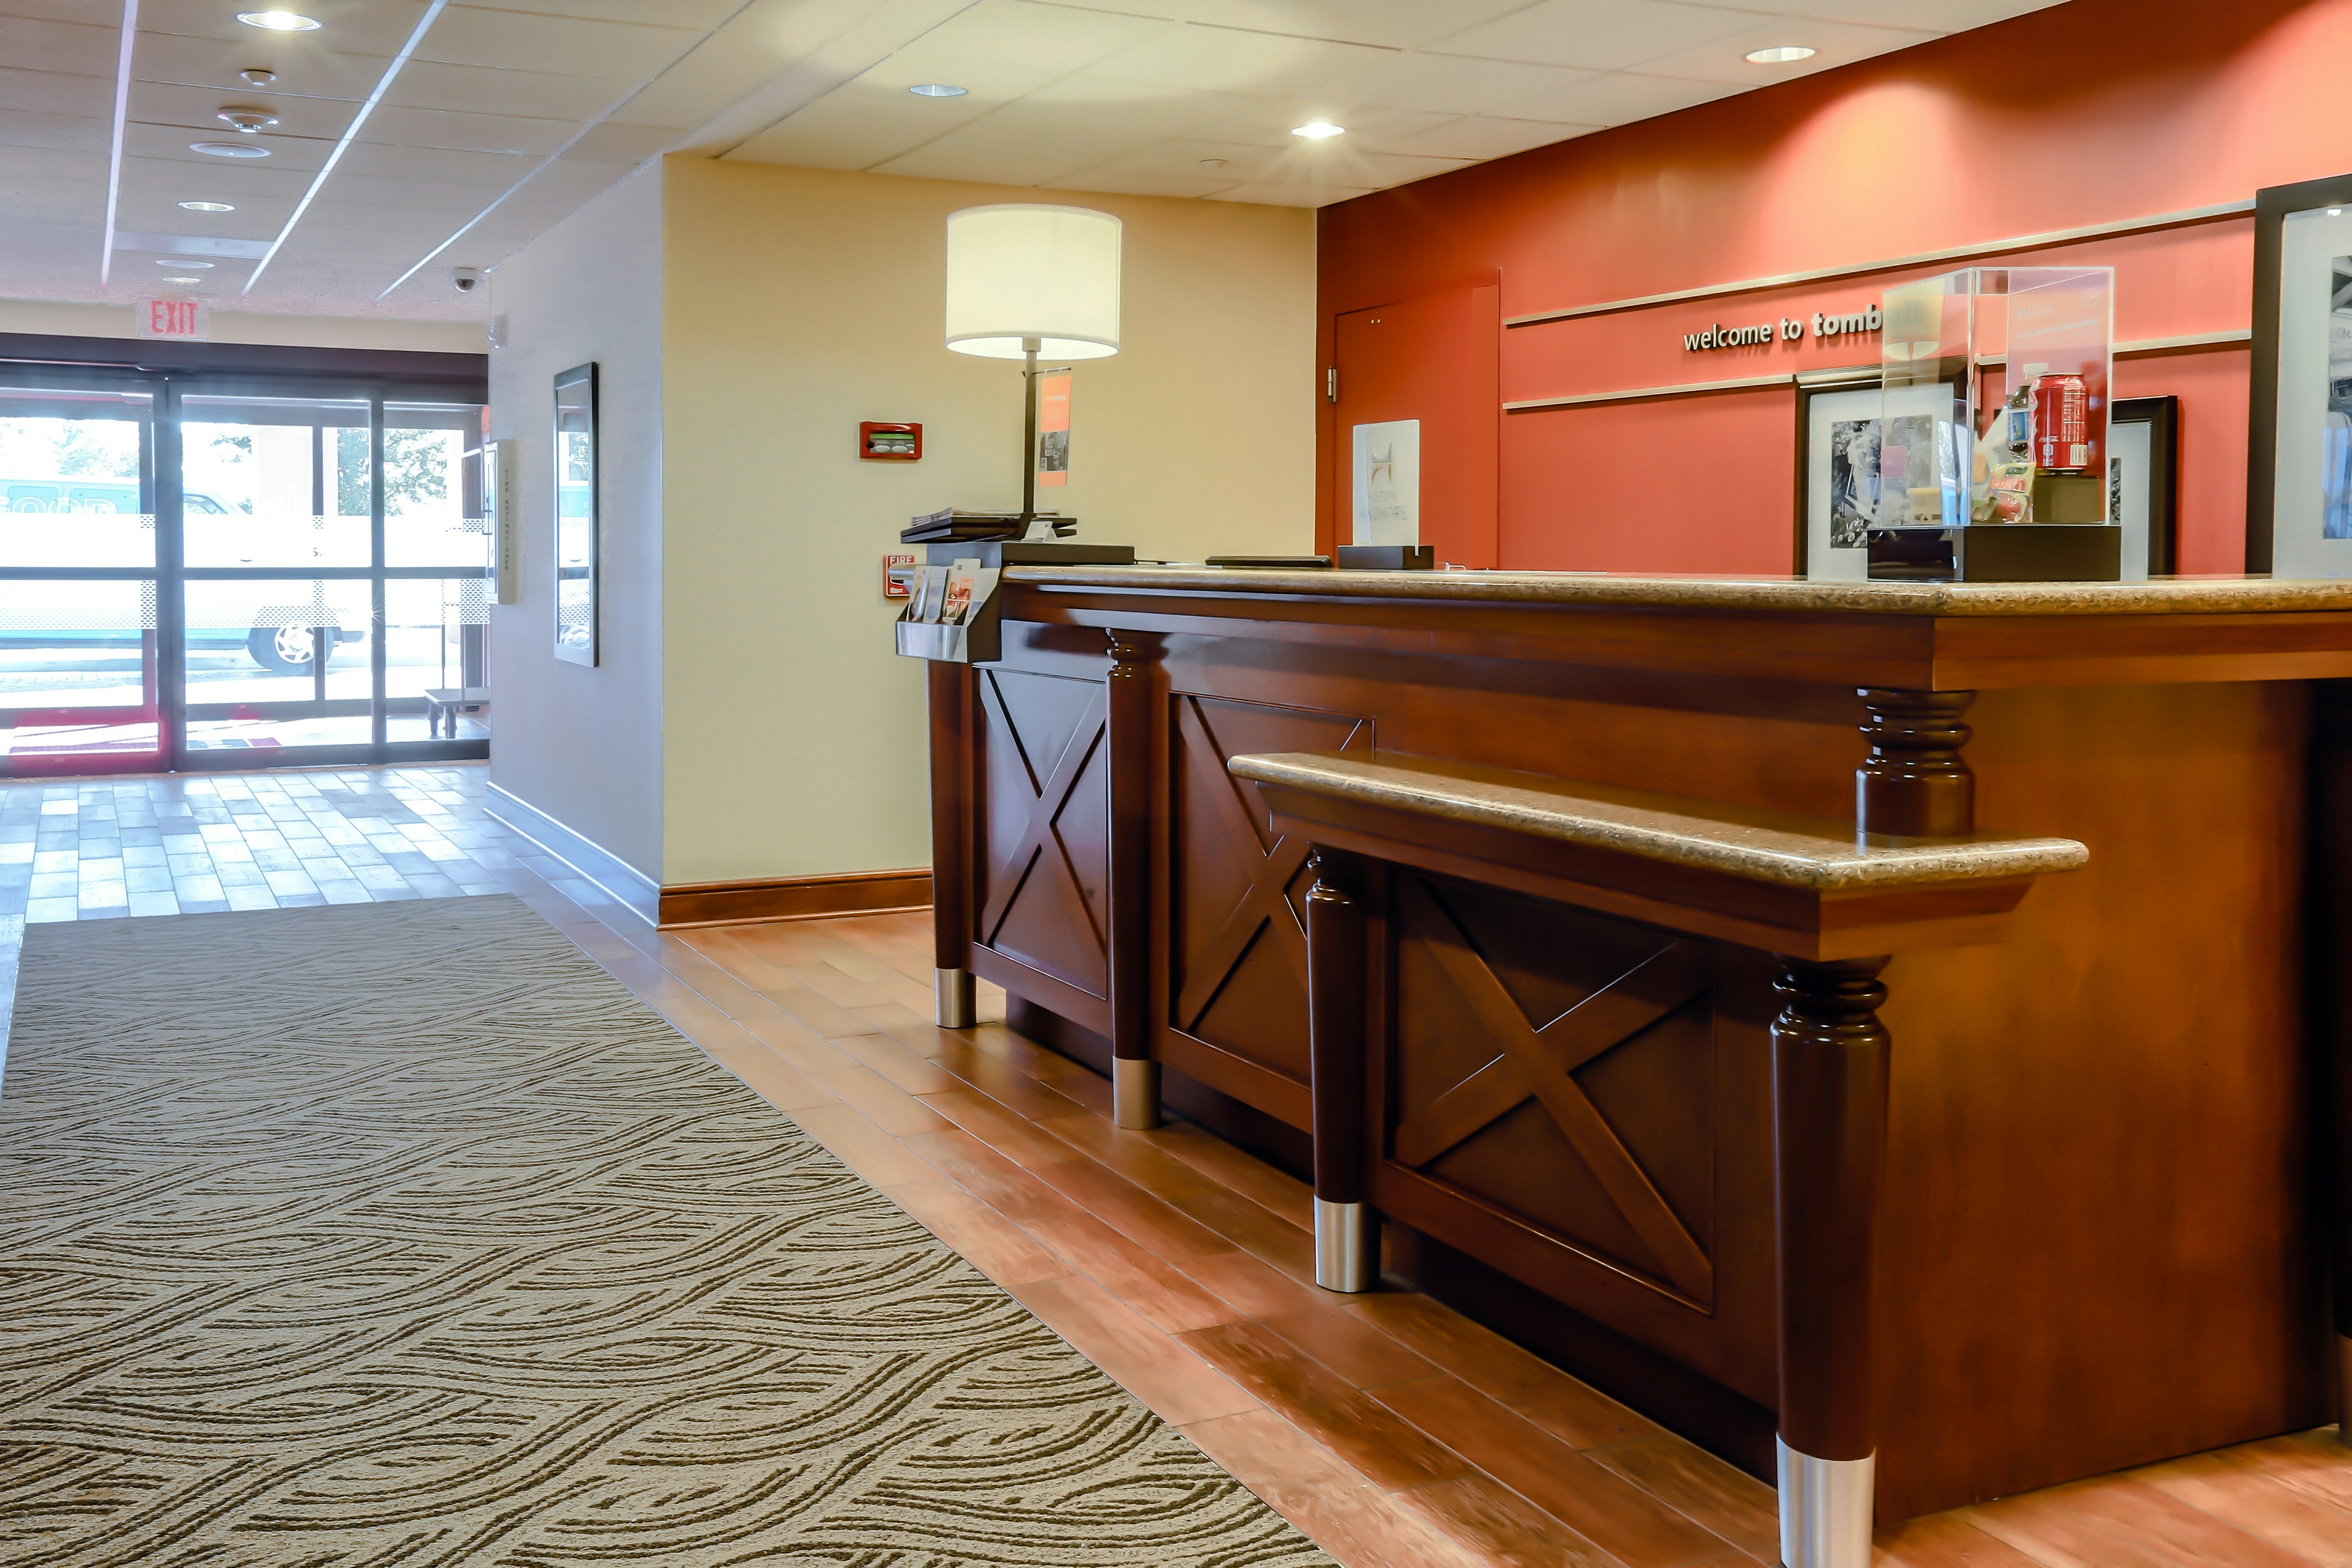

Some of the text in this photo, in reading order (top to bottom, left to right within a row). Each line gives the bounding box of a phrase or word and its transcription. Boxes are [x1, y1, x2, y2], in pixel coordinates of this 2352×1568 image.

[150, 300, 198, 335] EXIT
[1683, 323, 1773, 352] welcome
[1780, 317, 1804, 340] to
[890, 556, 913, 565] FIRE
